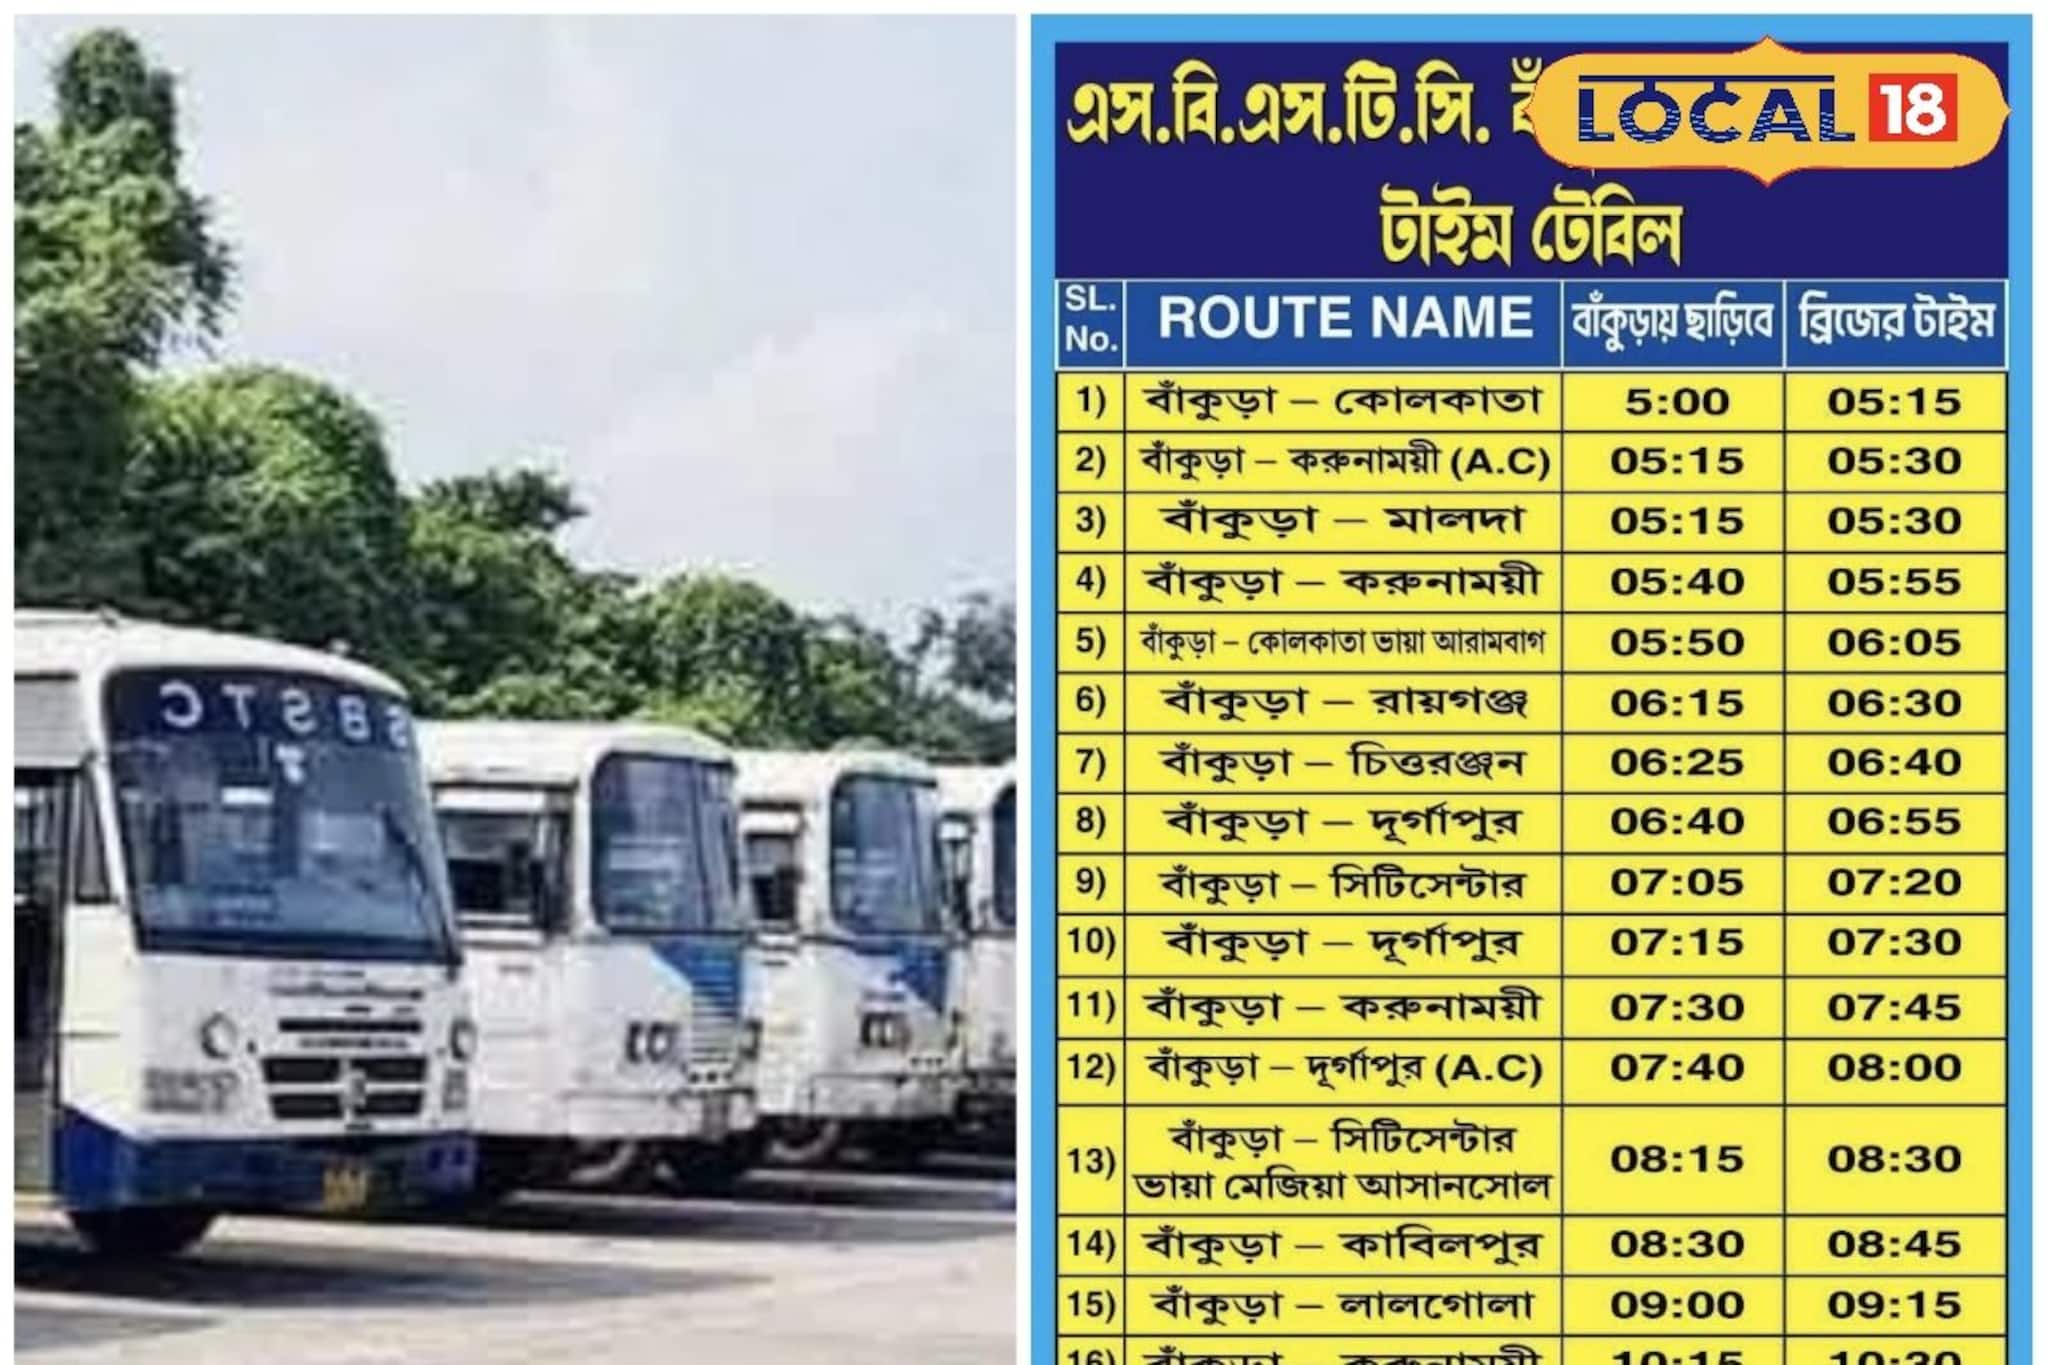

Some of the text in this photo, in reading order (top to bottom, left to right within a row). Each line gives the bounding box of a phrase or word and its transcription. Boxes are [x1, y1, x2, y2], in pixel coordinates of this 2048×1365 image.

[1379, 182, 1683, 267] টাইম টেবিল
[1066, 285, 1116, 311] SL.
[1161, 295, 1532, 338] ROUTE NAME
[1572, 290, 1774, 352] বাঁকুড়ায় ছাড়িবে
[1798, 290, 1996, 345] ব্রিজের টাইম
[1066, 326, 1118, 352] No.
[1077, 385, 1106, 419] 1)
[1142, 379, 1278, 421] বাঁকুড়া
[1334, 386, 1543, 415] কোলকাতা
[1626, 387, 1730, 416] 5:00
[1828, 387, 1961, 416] 05:15
[1076, 445, 1106, 479] 2)
[1139, 439, 1246, 480] বাঁকুড়া
[1450, 447, 1551, 482] (A.C)
[1611, 446, 1744, 475] 05:15
[1828, 446, 1962, 475] 05:30
[1076, 505, 1106, 539] 3)
[1159, 498, 1319, 541] বাঁকুড়া
[1383, 505, 1527, 534] মালদা
[1610, 506, 1744, 535] 05:15
[1827, 506, 1962, 535] 05:30
[1076, 565, 1106, 599] 4)
[1143, 561, 1284, 603] বাঁকুড়া
[1611, 567, 1745, 596] 05:40
[1827, 567, 1961, 596] 05:55
[1076, 626, 1106, 660] 5)
[1139, 622, 1216, 661] বাঁকুড়া
[1248, 629, 1367, 655] কোলকাতা
[1371, 629, 1427, 654] ভায়া
[1431, 629, 1547, 654] আরামবাগ
[1611, 628, 1745, 657] 05:50
[1828, 628, 1961, 657] 06:05
[1076, 685, 1106, 719] 6)
[1160, 680, 1309, 722] বাঁকুড়া
[1610, 688, 1744, 718] 06:15
[1827, 688, 1962, 718] 06:30
[1076, 747, 1106, 782] 7)
[1158, 741, 1293, 784] বাঁকুড়া
[1611, 748, 1744, 777] 06:25
[1828, 748, 1962, 777] 06:40
[1076, 805, 1106, 840] 8)
[1162, 801, 1310, 842] বাঁকুড়া
[1611, 807, 1745, 836] 06:40
[1827, 807, 1961, 836] 06:55
[1076, 866, 1106, 900] 9)
[1158, 864, 1281, 906] বাঁকুড়া
[1328, 863, 1528, 899] সিটিসেন্টার
[1611, 868, 1744, 897] 07:05
[1828, 868, 1962, 897] 07:20
[1067, 926, 1116, 961] 10)
[1162, 921, 1310, 963] বাঁকুড়া
[1611, 927, 1744, 956] 07:15
[1827, 928, 1962, 956] 07:30
[1067, 990, 1116, 1024] 11)
[1142, 986, 1284, 1028] বাঁকুড়া
[1611, 993, 1745, 1021] 07:30
[1828, 993, 1961, 1021] 07:45
[1067, 1052, 1116, 1086] 12)
[1144, 1046, 1260, 1088] বাঁকুড়া
[1435, 1054, 1543, 1088] (A.C)
[1611, 1053, 1745, 1082] 07:40
[1828, 1053, 1962, 1082] 08:00
[1167, 1119, 1284, 1160] বাঁকুড়া
[1329, 1117, 1518, 1154] সিটিসেন্টার
[1068, 1146, 1116, 1181] 13)
[1611, 1144, 1744, 1173] 08:15
[1827, 1144, 1962, 1173] 08:30
[1132, 1158, 1554, 1200] ভায়া মেজিয়া আসানসোল
[1068, 1229, 1116, 1263] 14)
[1141, 1224, 1283, 1266] বাঁকুড়া
[1338, 1223, 1544, 1266] কাবিলপুর
[1611, 1229, 1745, 1258] 08:30
[1828, 1229, 1961, 1258] 08:45
[1067, 1290, 1116, 1324] 15)
[1151, 1284, 1284, 1326] বাঁকুড়া
[1337, 1291, 1536, 1320] লালগোলা
[1611, 1290, 1745, 1320] 09:00
[1827, 1290, 1961, 1320] 09:15
